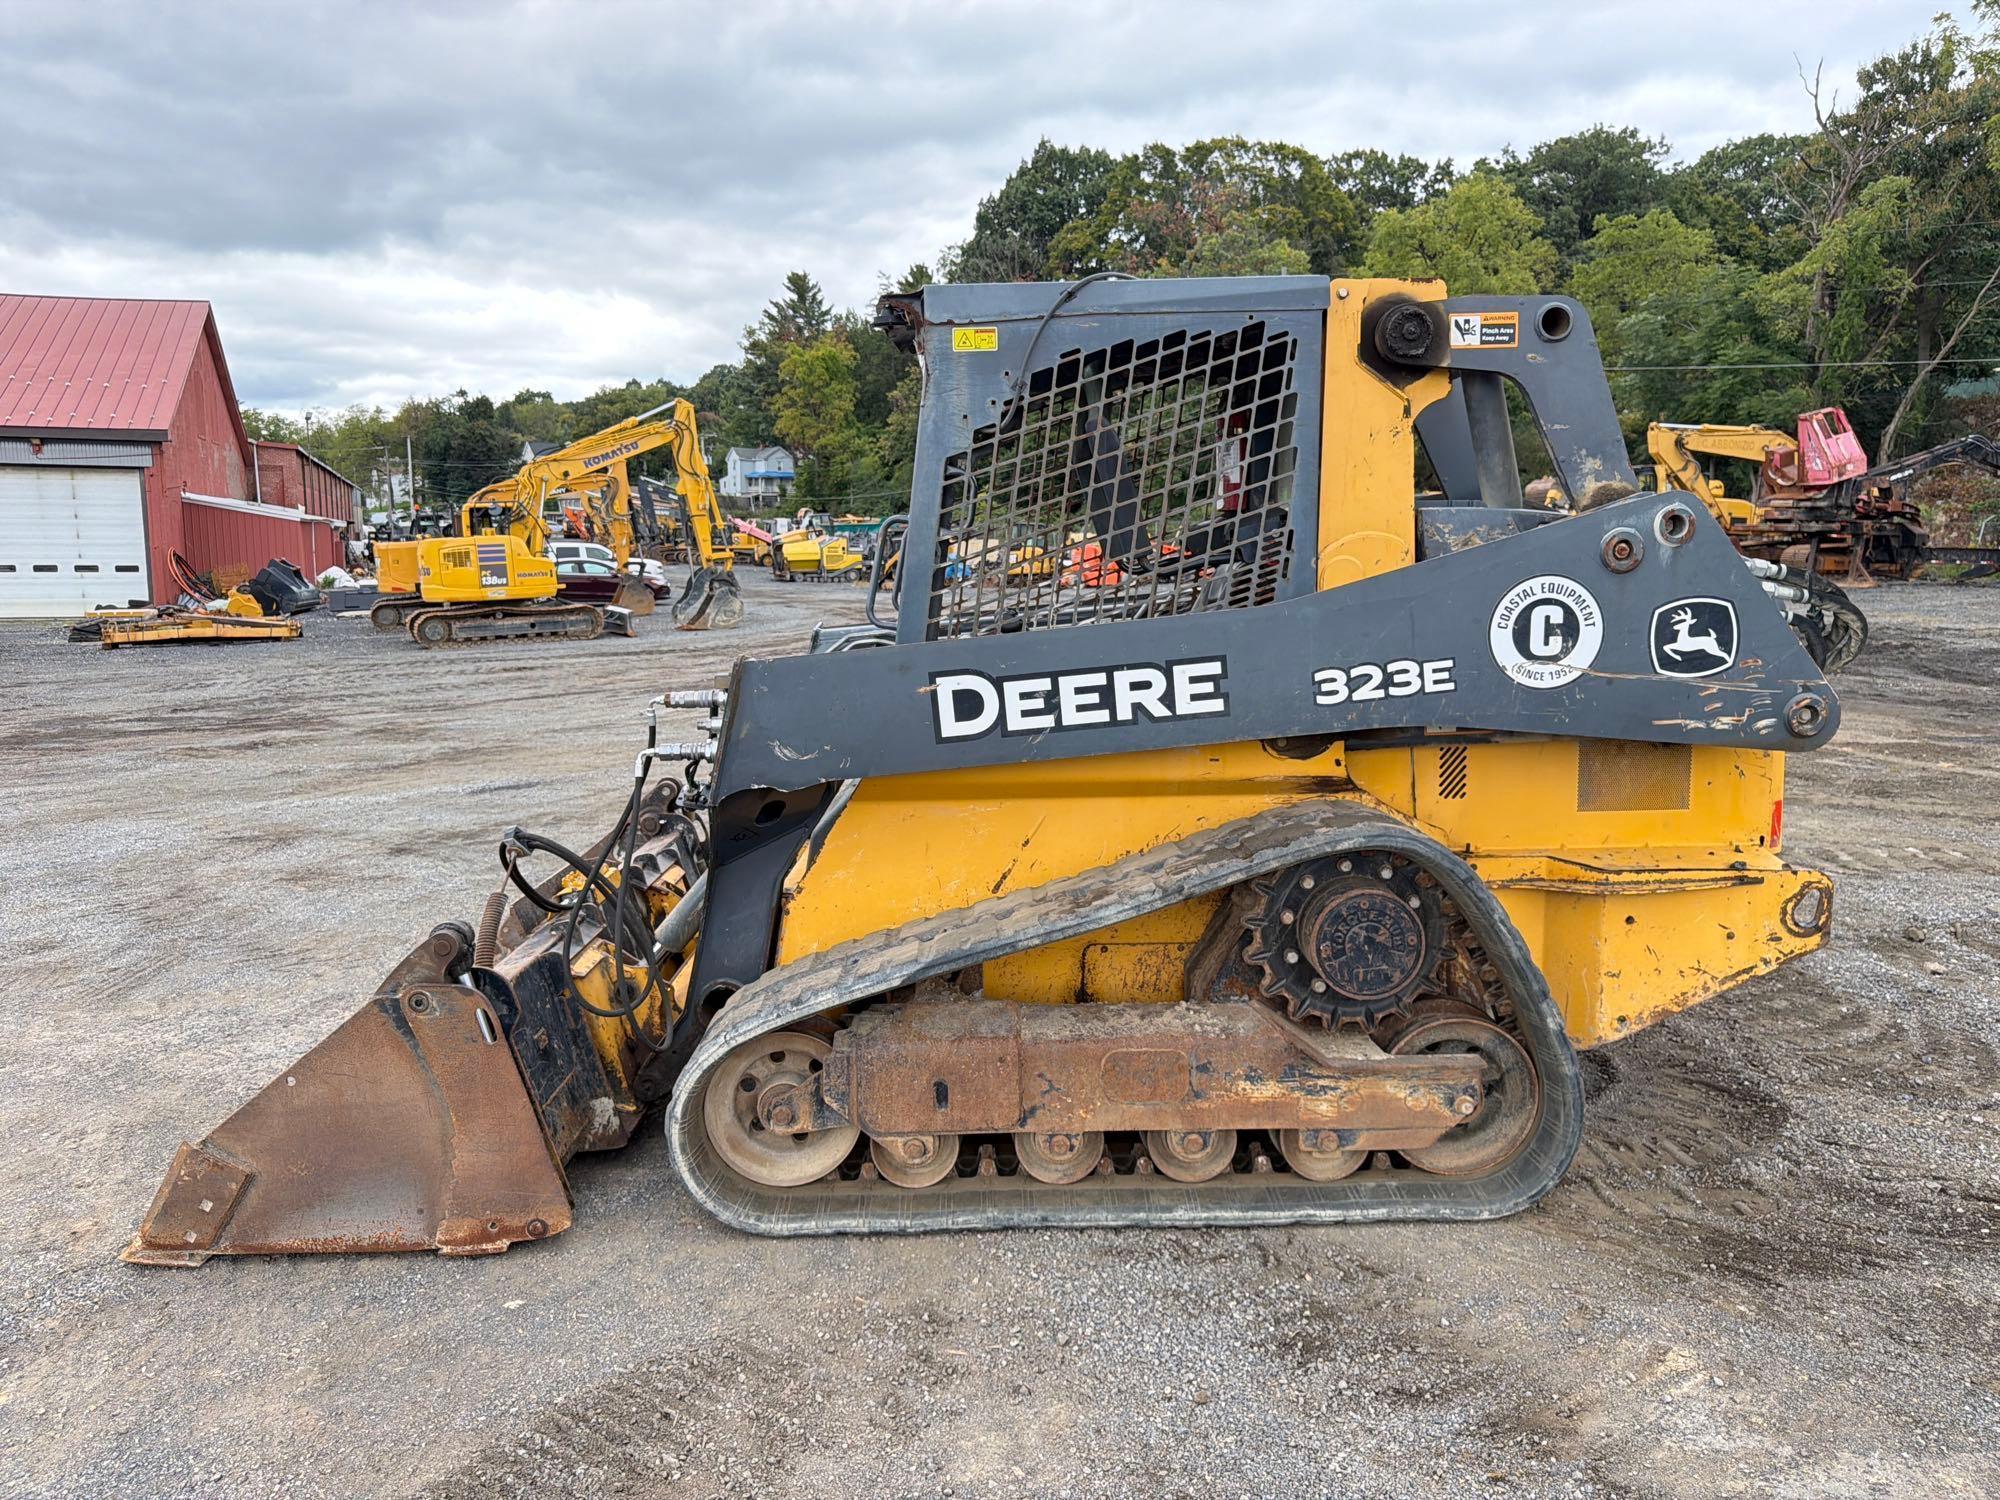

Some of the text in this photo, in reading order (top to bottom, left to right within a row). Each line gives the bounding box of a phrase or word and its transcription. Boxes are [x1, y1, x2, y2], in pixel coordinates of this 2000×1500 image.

[583, 441, 639, 469] KOMATSU
[1497, 582, 1597, 631] COASTAL EQUIPMENT
[1529, 605, 1564, 656] C
[934, 660, 1226, 739] DEERE
[1313, 658, 1456, 705] 323E
